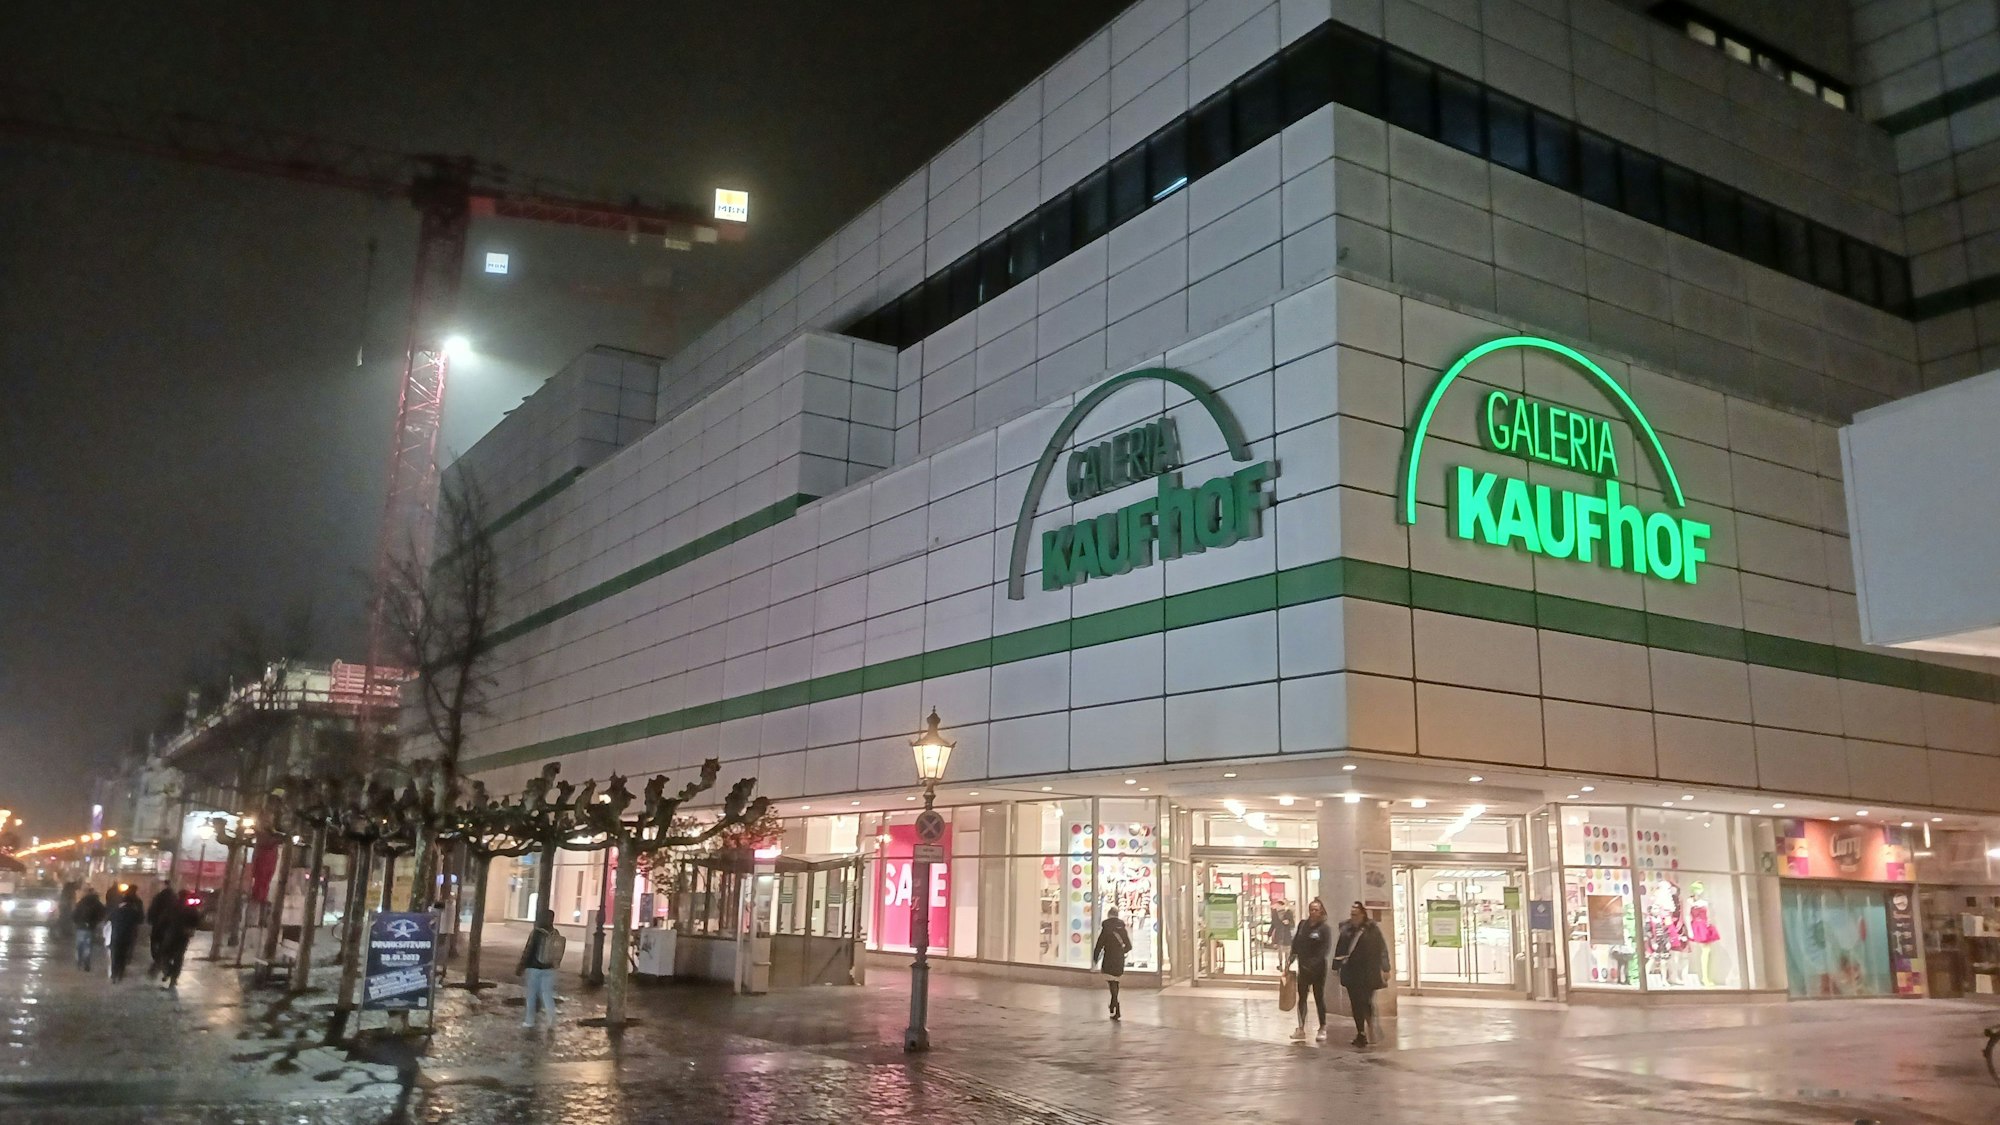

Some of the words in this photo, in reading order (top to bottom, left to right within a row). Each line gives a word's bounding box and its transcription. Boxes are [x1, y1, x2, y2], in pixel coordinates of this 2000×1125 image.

[1067, 417, 1181, 501] GALERIA
[1487, 391, 1618, 476] GALERIA
[885, 863, 948, 907] SAE
